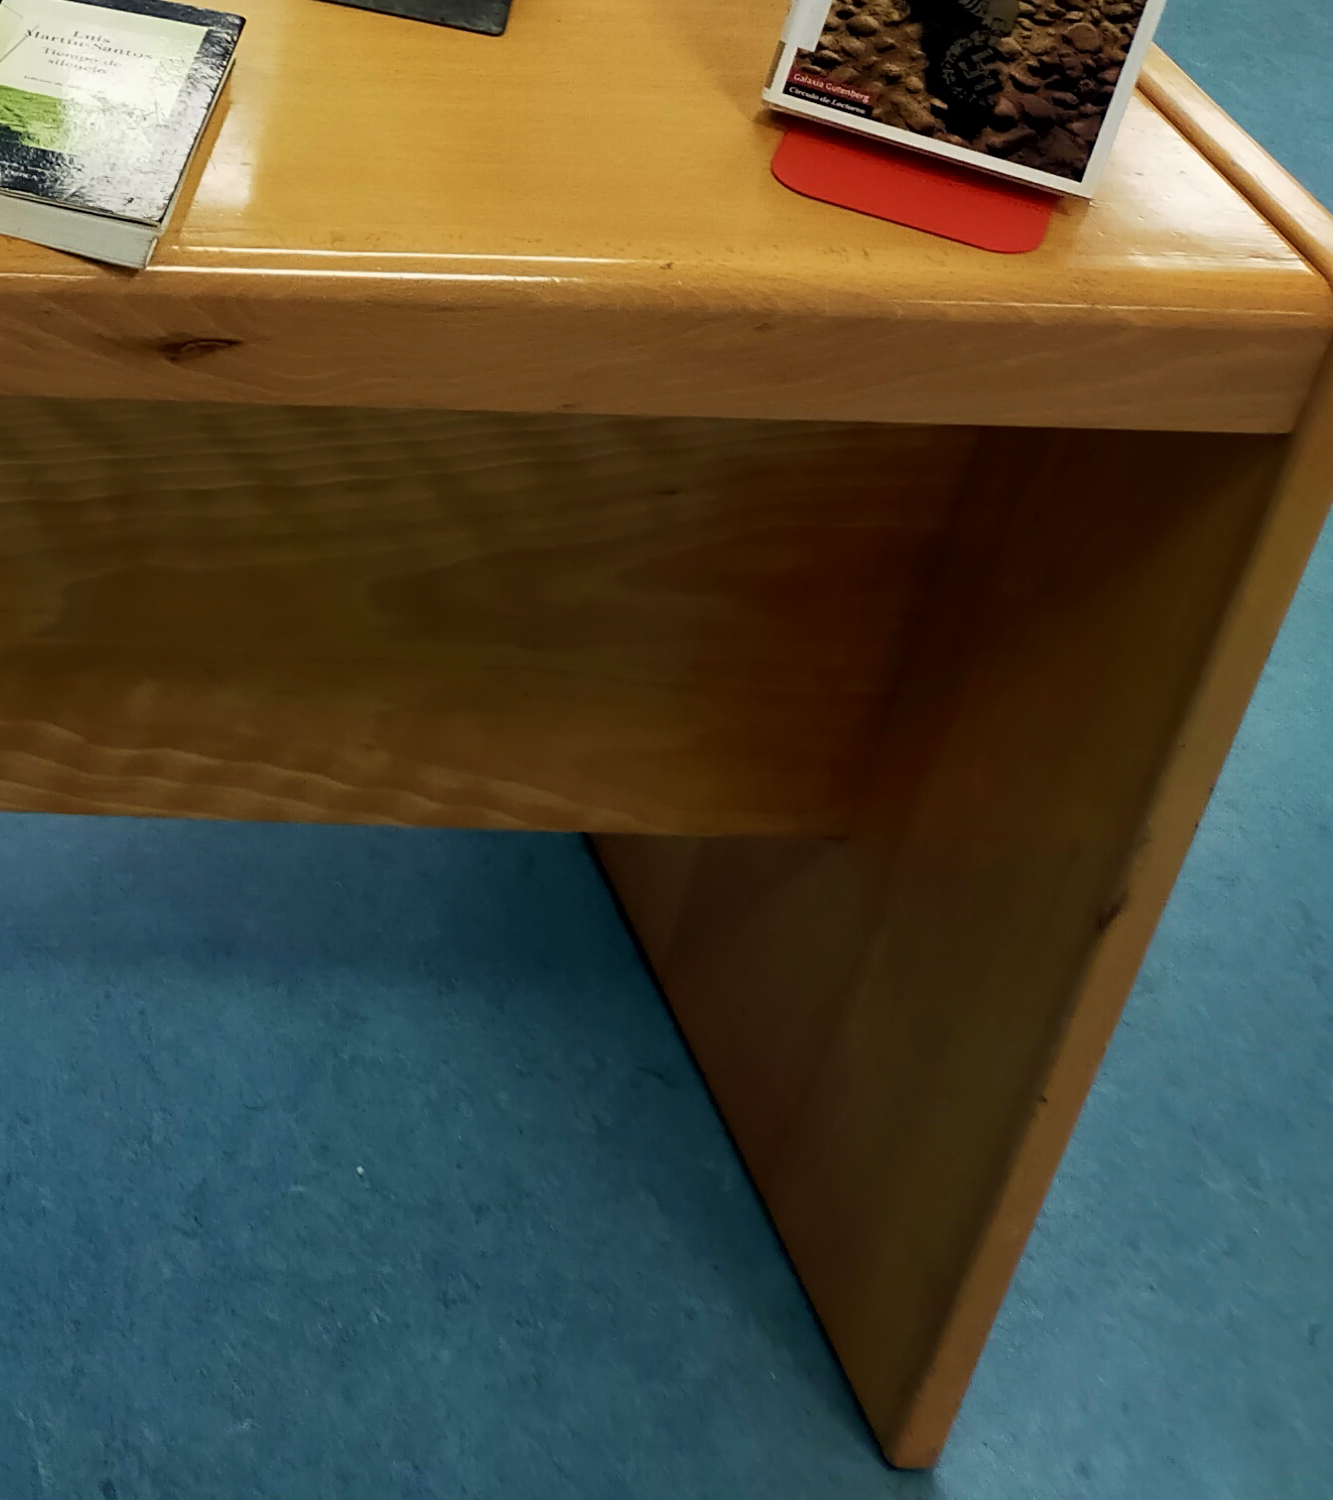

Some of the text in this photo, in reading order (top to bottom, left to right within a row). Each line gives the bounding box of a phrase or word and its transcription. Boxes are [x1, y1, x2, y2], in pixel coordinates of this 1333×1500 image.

[73, 30, 111, 44] Luis
[43, 46, 99, 62] Tiempo
[819, 94, 831, 104] de
